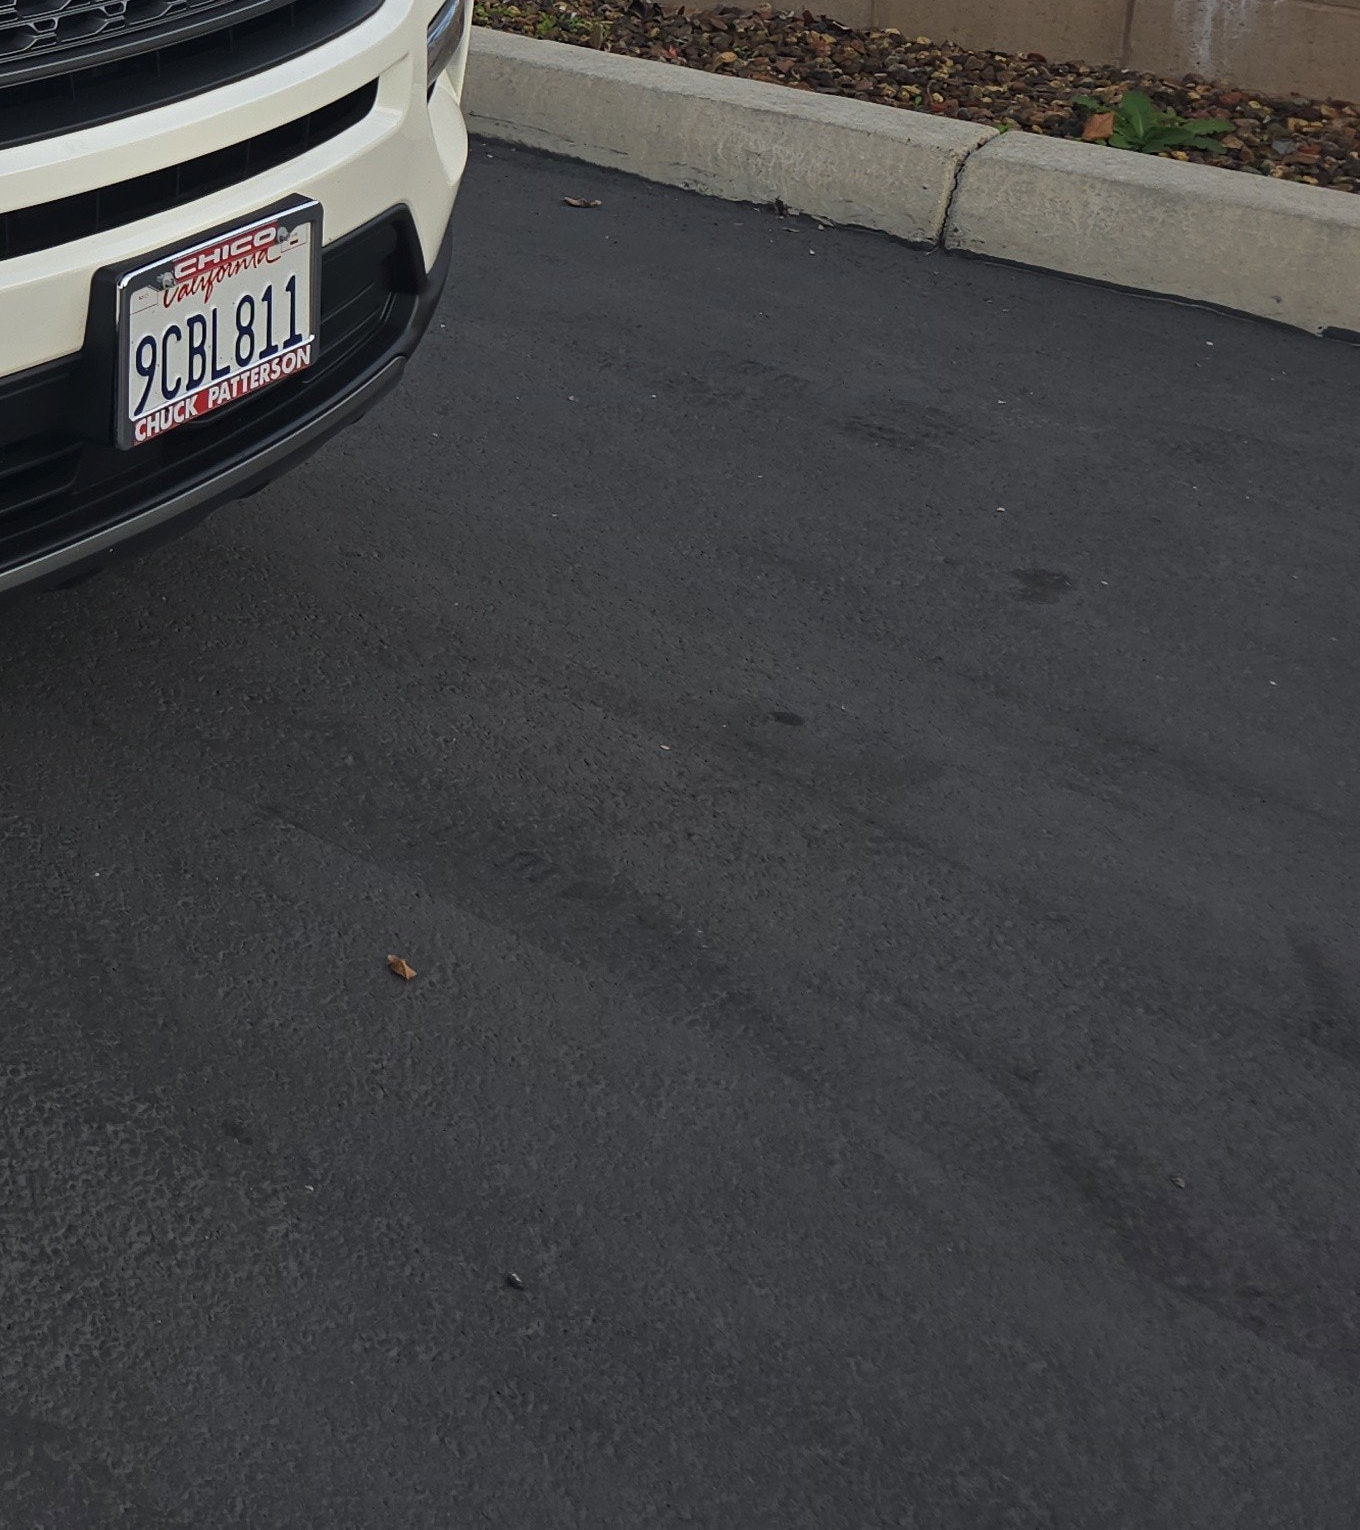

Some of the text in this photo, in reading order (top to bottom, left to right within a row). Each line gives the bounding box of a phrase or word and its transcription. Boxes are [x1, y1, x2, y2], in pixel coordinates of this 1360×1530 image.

[162, 246, 282, 309] California
[173, 226, 278, 282] CHICO
[134, 274, 304, 417] 9CBL811
[134, 344, 312, 443] CHUCK PATTERSON
